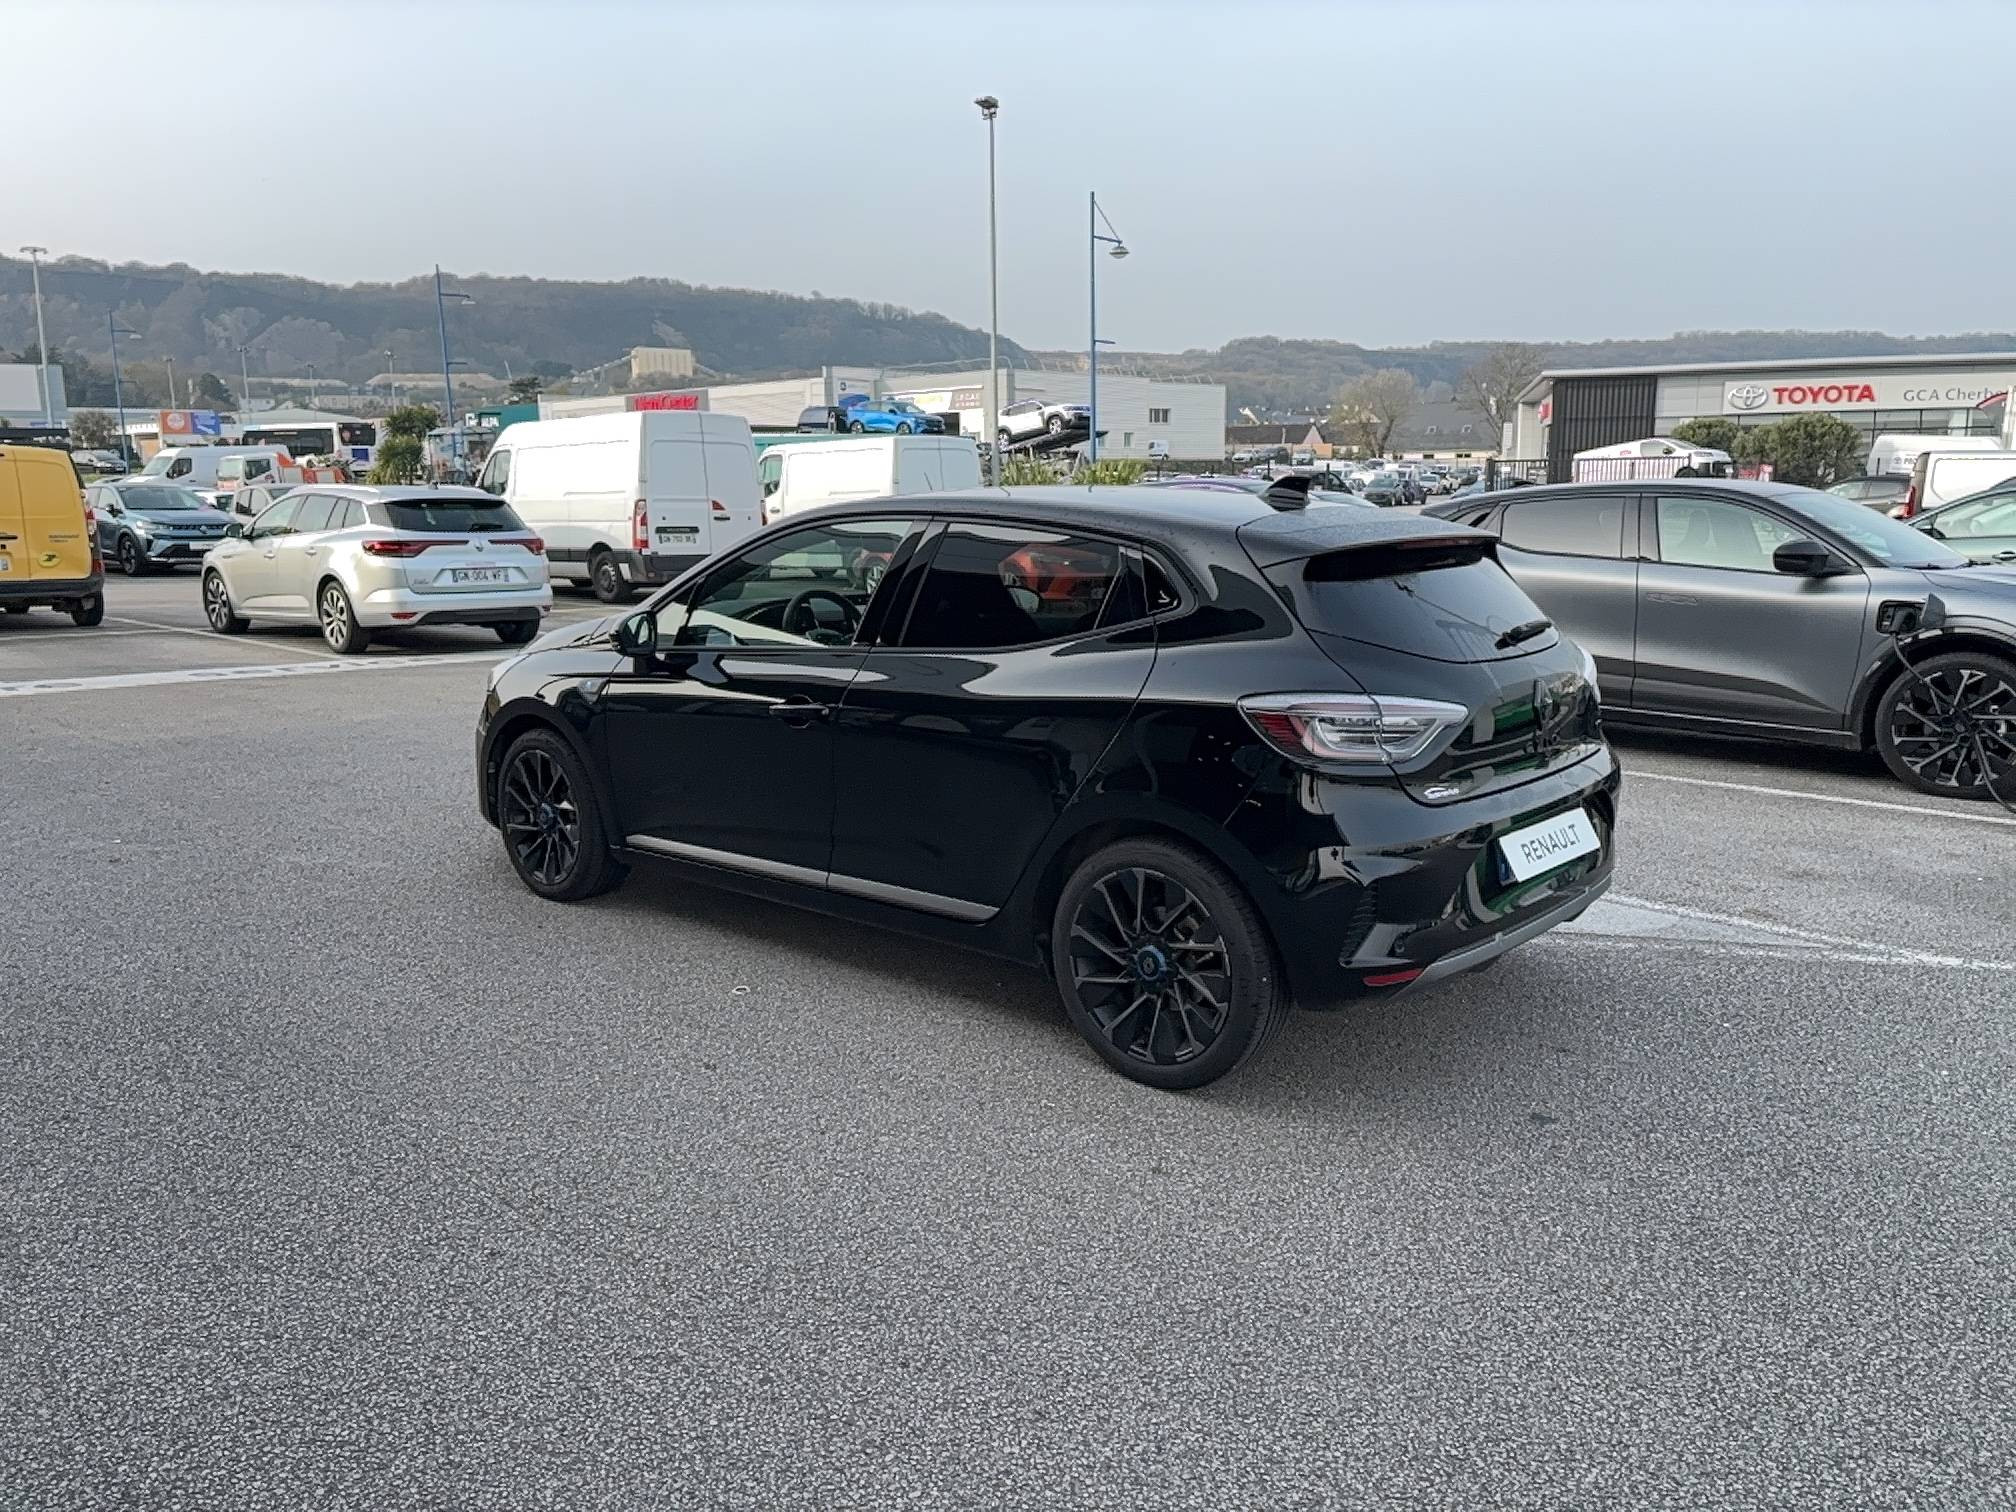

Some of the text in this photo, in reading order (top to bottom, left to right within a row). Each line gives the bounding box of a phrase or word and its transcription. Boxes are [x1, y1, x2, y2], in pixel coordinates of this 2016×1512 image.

[1773, 384, 1875, 405] TOYOTA
[1903, 389, 1940, 402] GCA
[1521, 823, 1581, 864] RENAULT
